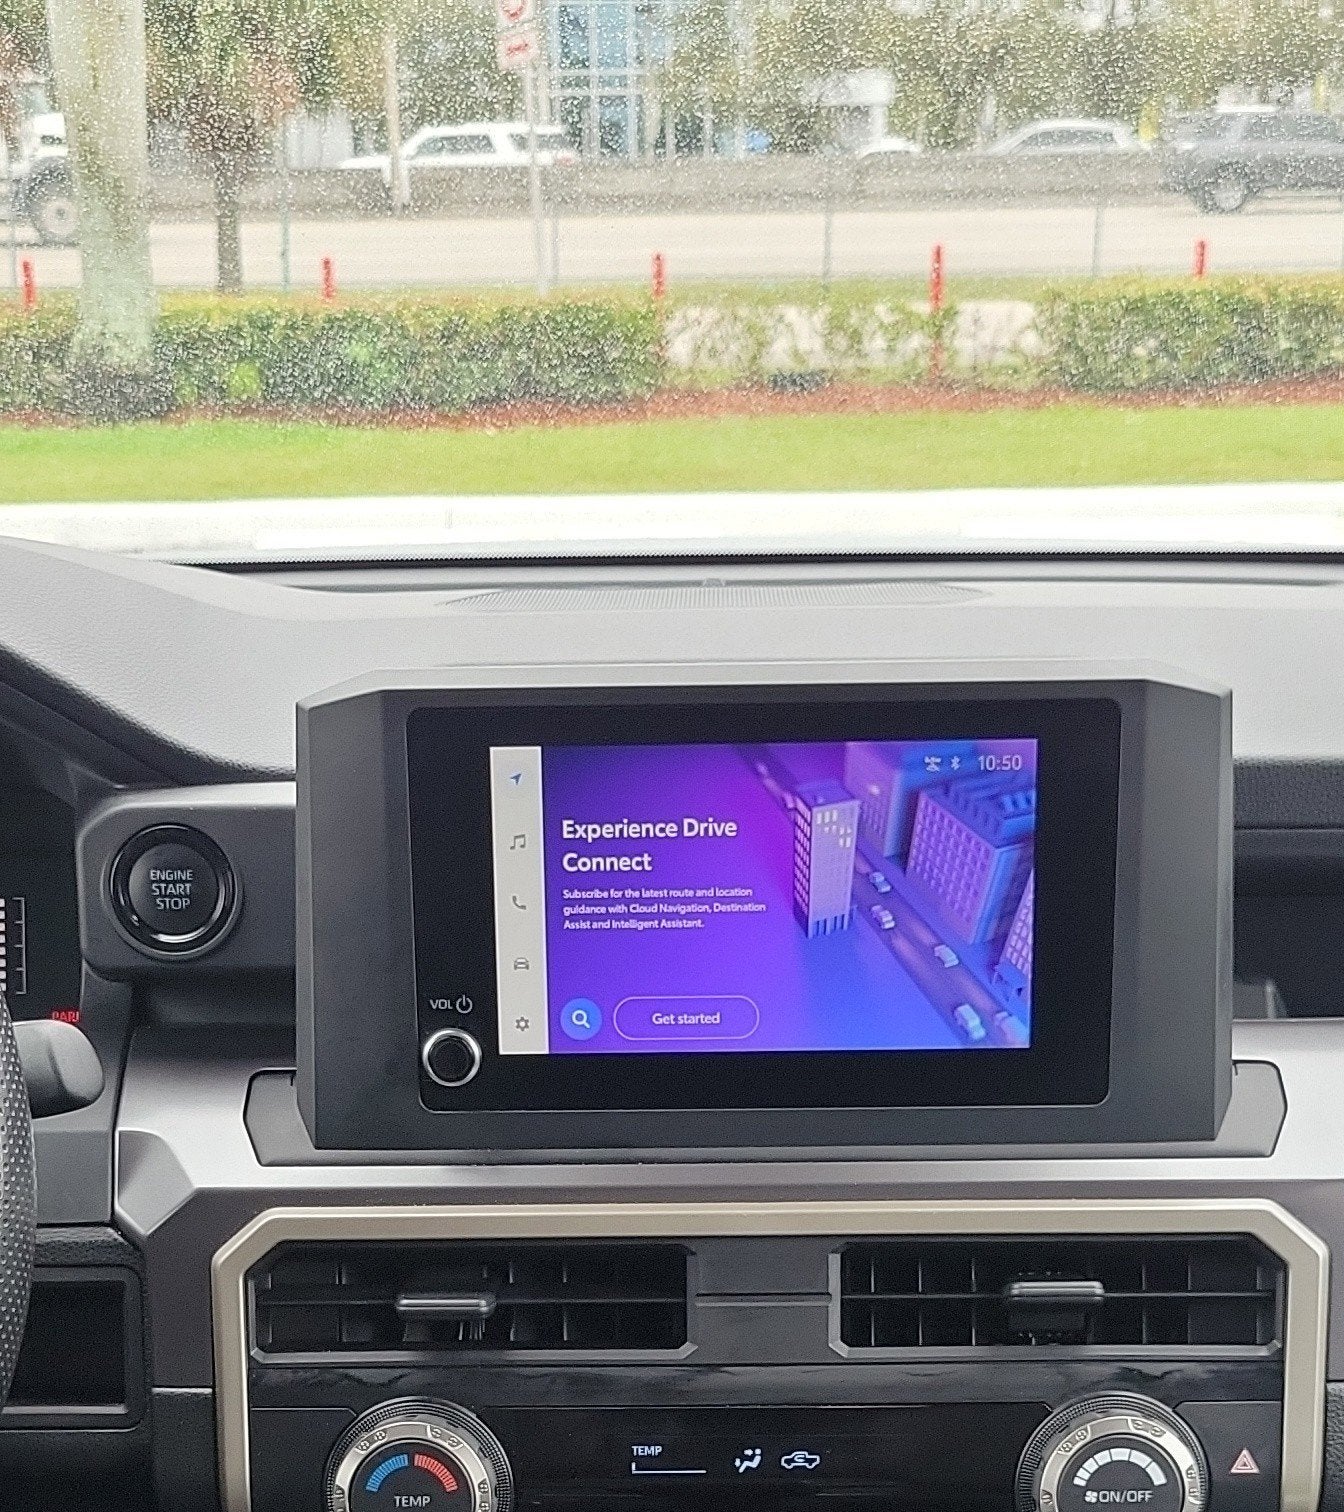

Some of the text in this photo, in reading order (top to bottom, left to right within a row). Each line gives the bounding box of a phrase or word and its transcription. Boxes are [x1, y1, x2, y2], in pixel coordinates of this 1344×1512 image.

[978, 754, 1022, 771] 10:50
[561, 817, 738, 842] Experience Drive
[562, 852, 653, 872] Connect
[150, 869, 193, 881] ENGINE
[151, 883, 192, 895] START
[563, 887, 753, 900] Subscribe for the latest route and location
[156, 897, 191, 910] STOP
[563, 902, 767, 917] guidance with Cloud Navigation, Destination
[563, 918, 705, 931] Assist and Intelligent Assistant.
[429, 999, 453, 1010] VOL
[652, 1011, 721, 1025] Get started
[631, 1445, 663, 1457] TEMP
[394, 1495, 431, 1508] TEMP
[1098, 1489, 1154, 1504] ON/OFF
